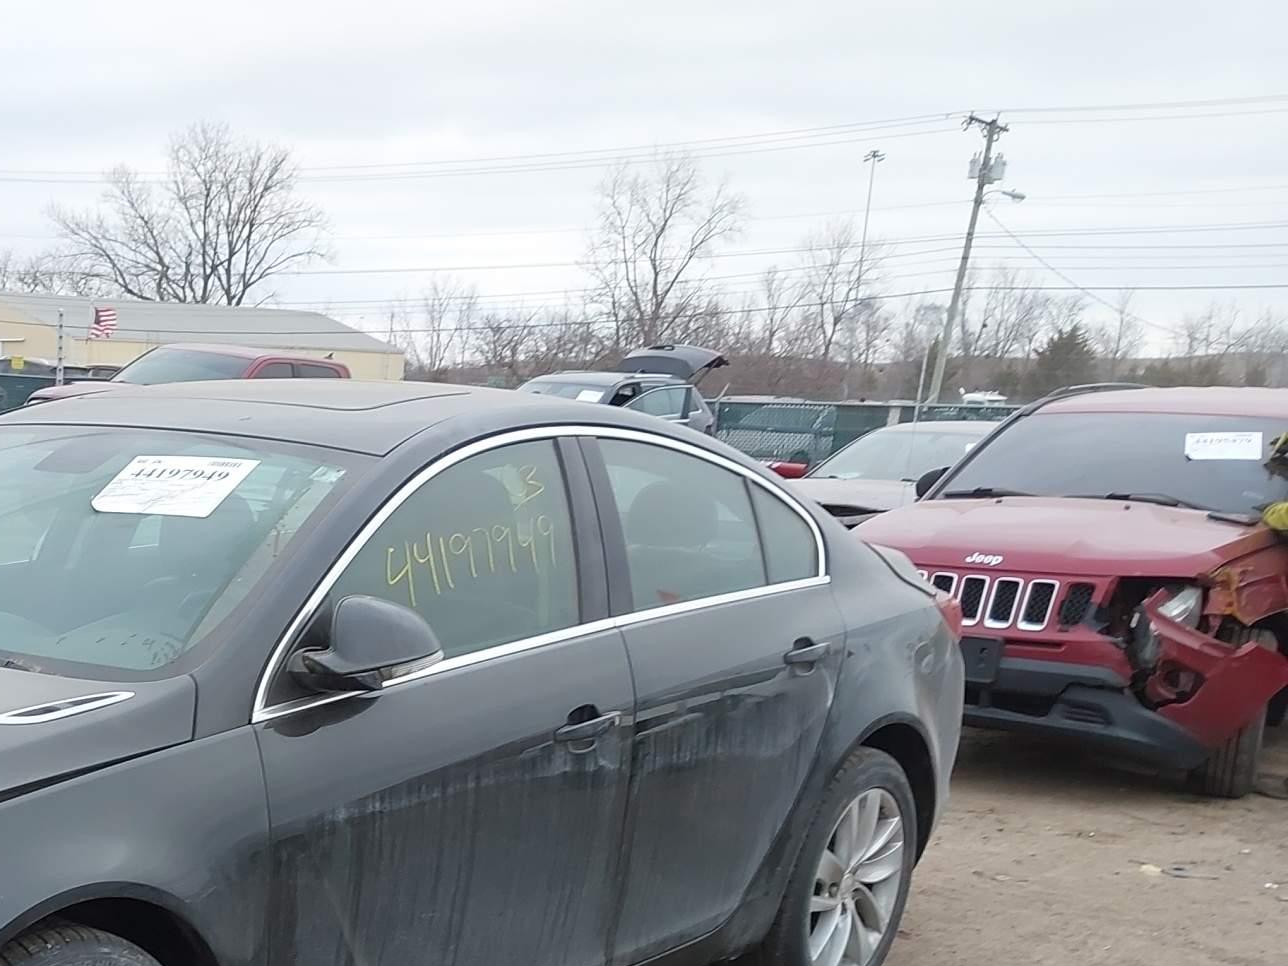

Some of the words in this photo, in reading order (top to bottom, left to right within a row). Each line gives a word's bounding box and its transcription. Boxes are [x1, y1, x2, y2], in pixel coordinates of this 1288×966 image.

[130, 467, 231, 481] 44197949
[386, 515, 557, 607] 44197949
[965, 552, 1004, 566] Jeep
